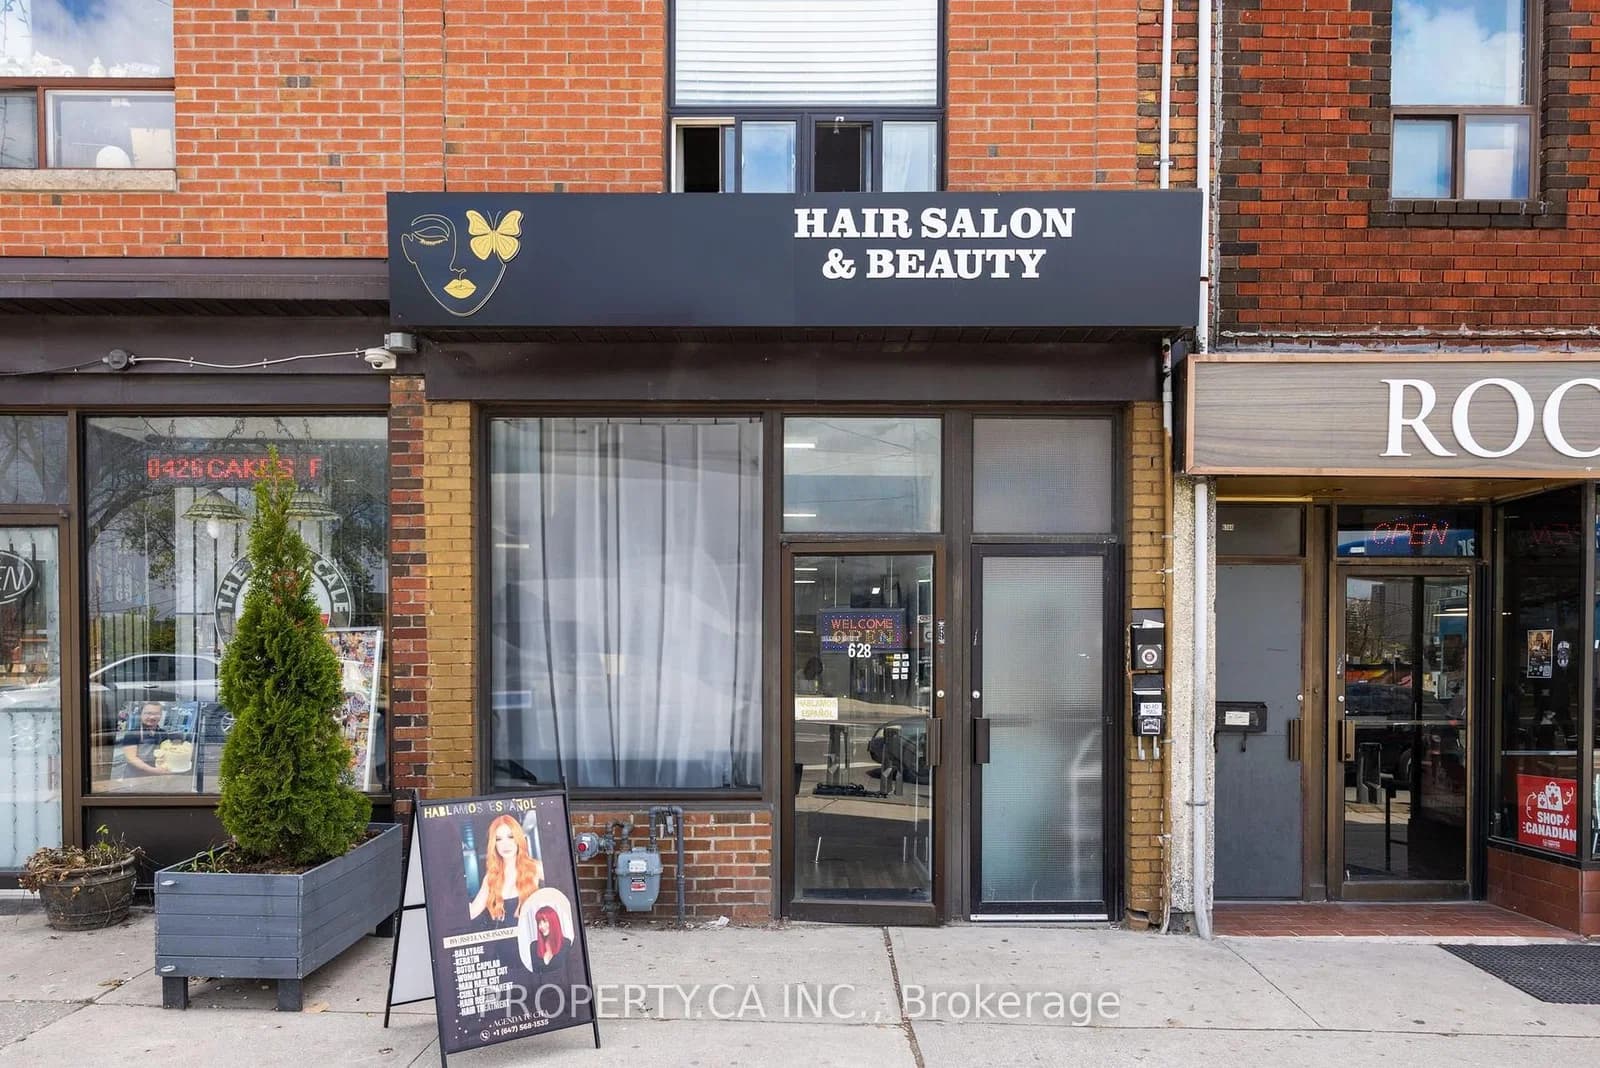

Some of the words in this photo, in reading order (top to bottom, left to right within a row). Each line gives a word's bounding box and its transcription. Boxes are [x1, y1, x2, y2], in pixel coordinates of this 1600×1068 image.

[794, 208, 912, 238] HAIR
[920, 207, 1076, 239] SALON
[822, 248, 856, 279] &
[866, 248, 1047, 279] BEAUTY
[1372, 521, 1449, 545] OPEN
[831, 618, 893, 629] WELCOME
[848, 642, 872, 658] 628
[424, 803, 483, 818] HABLAMOS
[489, 798, 537, 813] ESPAÑOL
[1537, 811, 1564, 826] SHOP
[1525, 821, 1577, 842] CANADIAN
